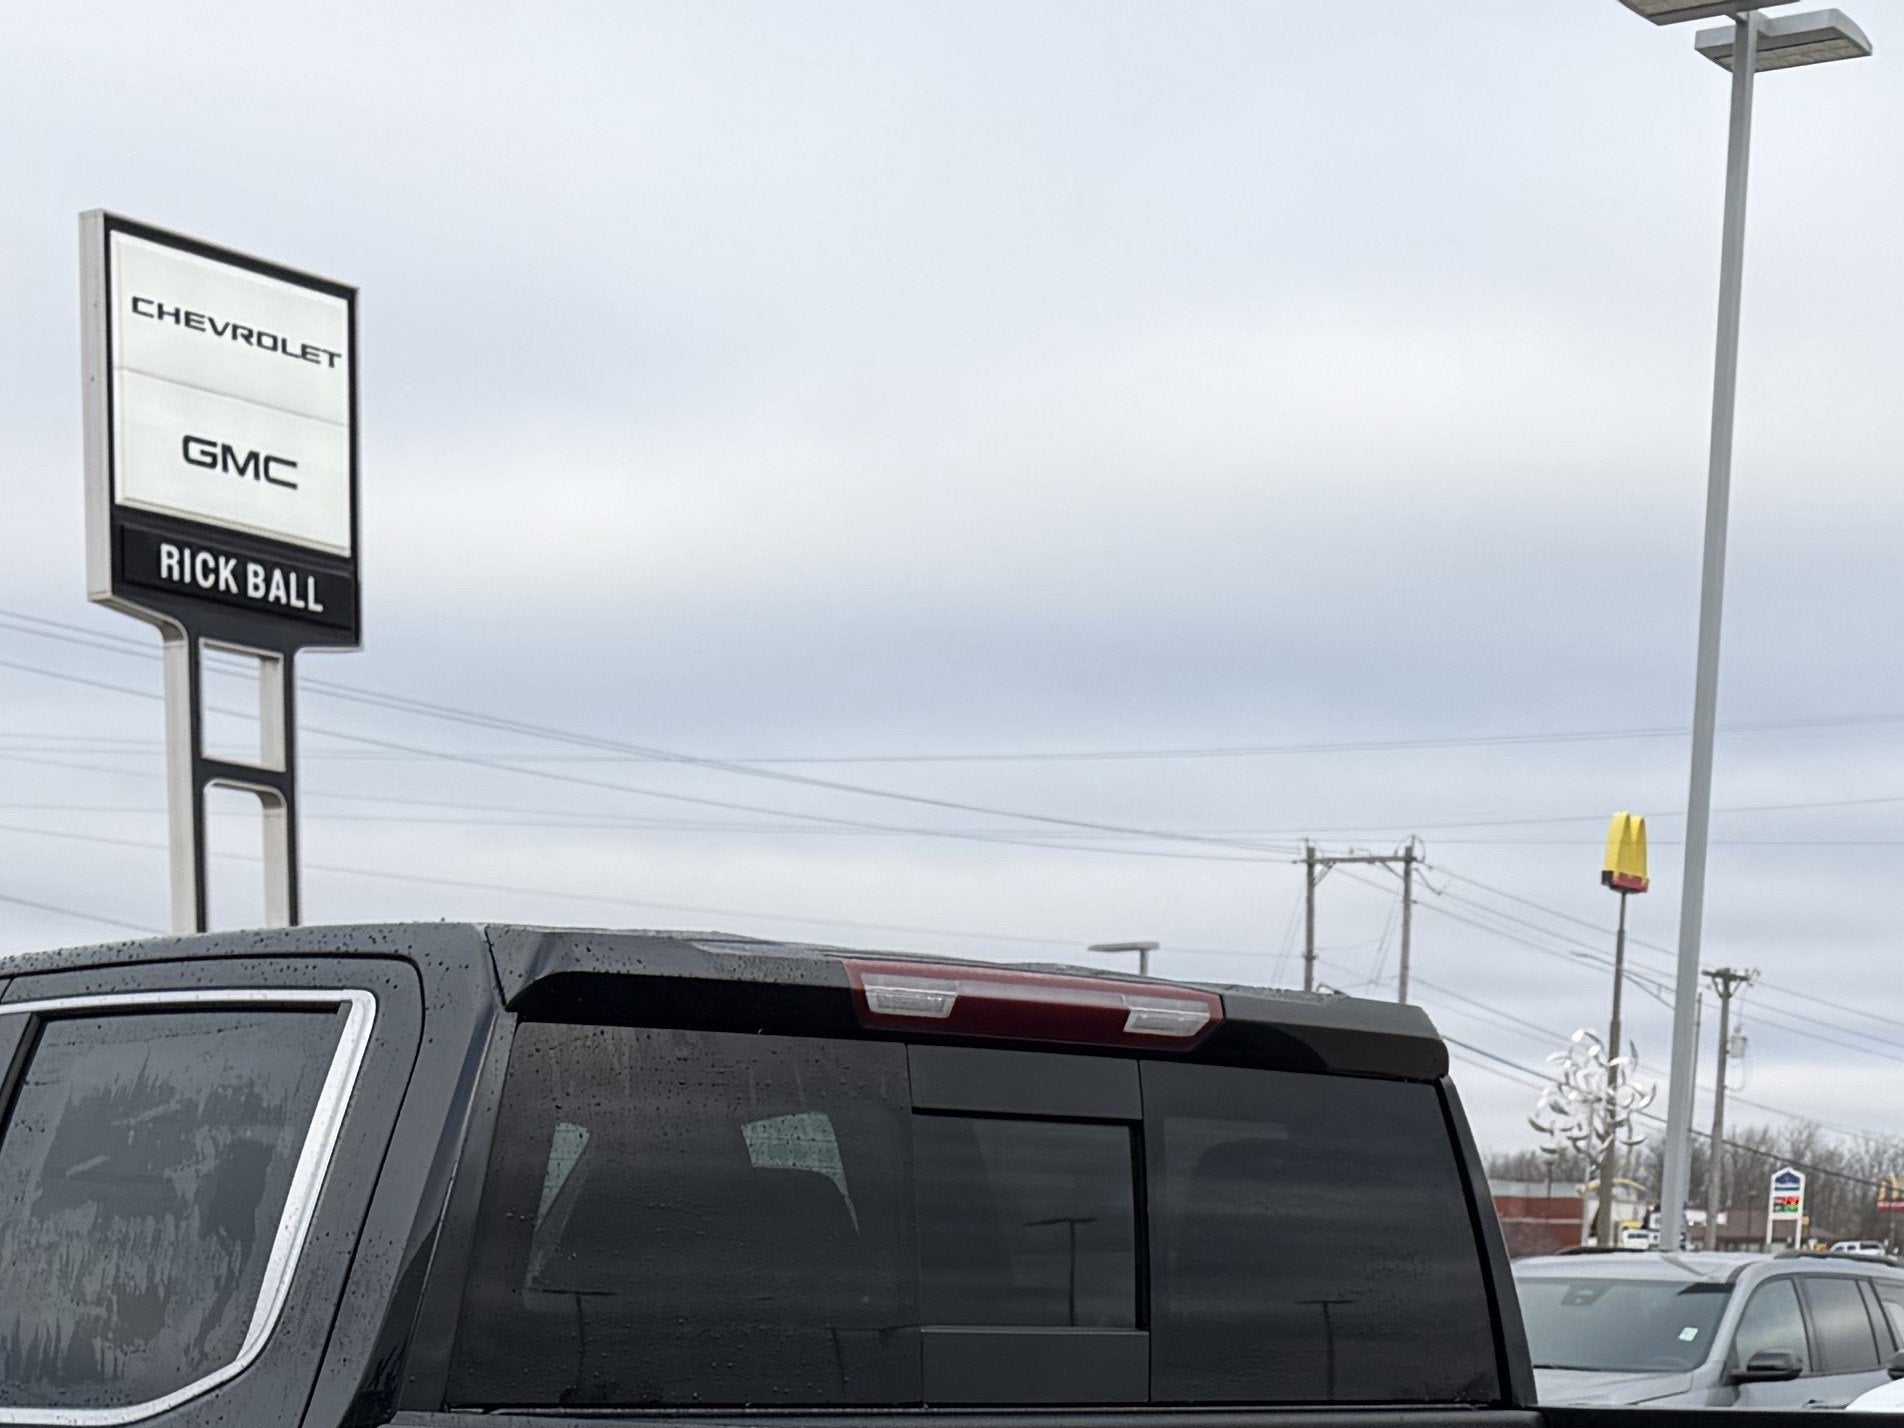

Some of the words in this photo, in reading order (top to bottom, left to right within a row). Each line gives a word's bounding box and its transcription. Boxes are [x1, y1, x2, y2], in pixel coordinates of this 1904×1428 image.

[131, 296, 342, 368] CHEVROLET
[182, 435, 298, 490] GMC
[159, 542, 239, 594] RICK
[246, 563, 324, 613] BALL
